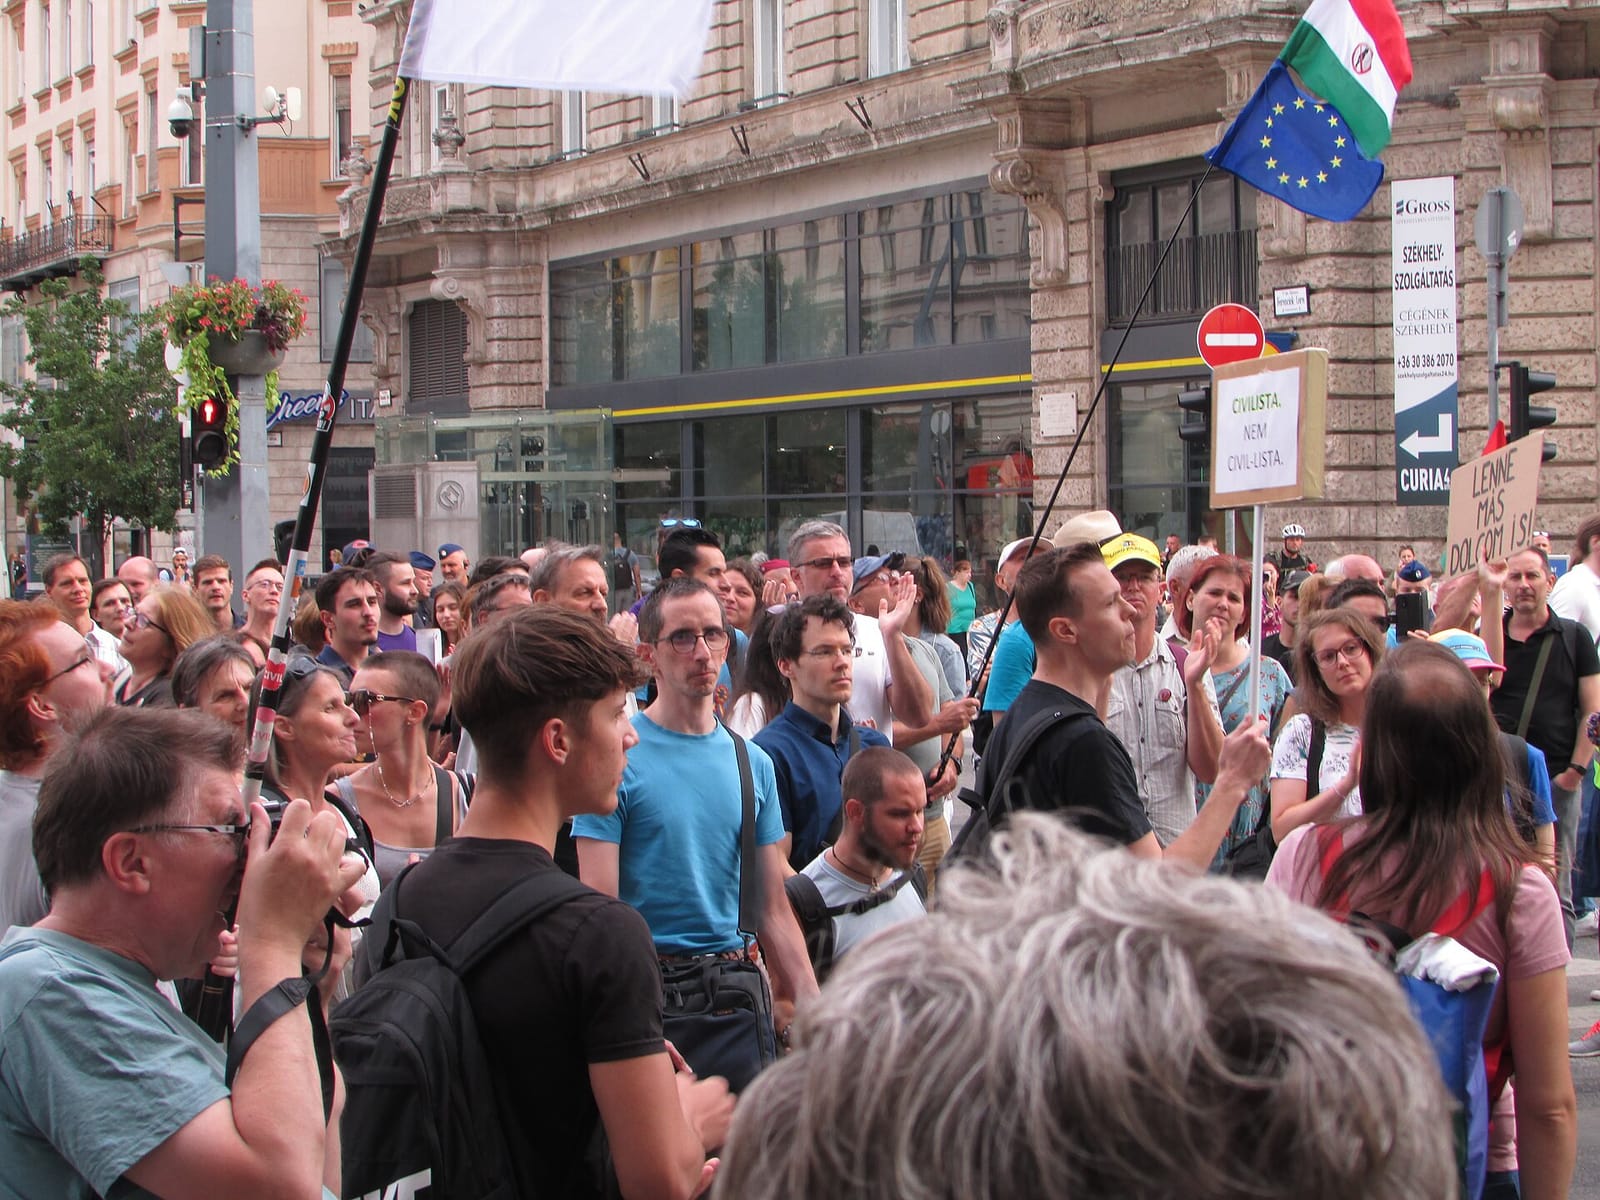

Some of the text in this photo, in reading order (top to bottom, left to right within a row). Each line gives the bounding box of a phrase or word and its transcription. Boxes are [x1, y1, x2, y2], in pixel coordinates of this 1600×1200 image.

[1405, 199, 1450, 215] GROSS
[1403, 242, 1445, 263] SZÉKHELY-
[1394, 266, 1454, 290] SZOLGÁLTATÁS
[1399, 308, 1449, 322] CÉGÉNEK
[1395, 322, 1454, 337] SZÉKHELYE
[1397, 352, 1454, 369] +36 30 386 2070
[1243, 423, 1267, 441] NEM
[1227, 449, 1284, 472] CIVIL-LISTA.
[1472, 448, 1517, 498] LENNE
